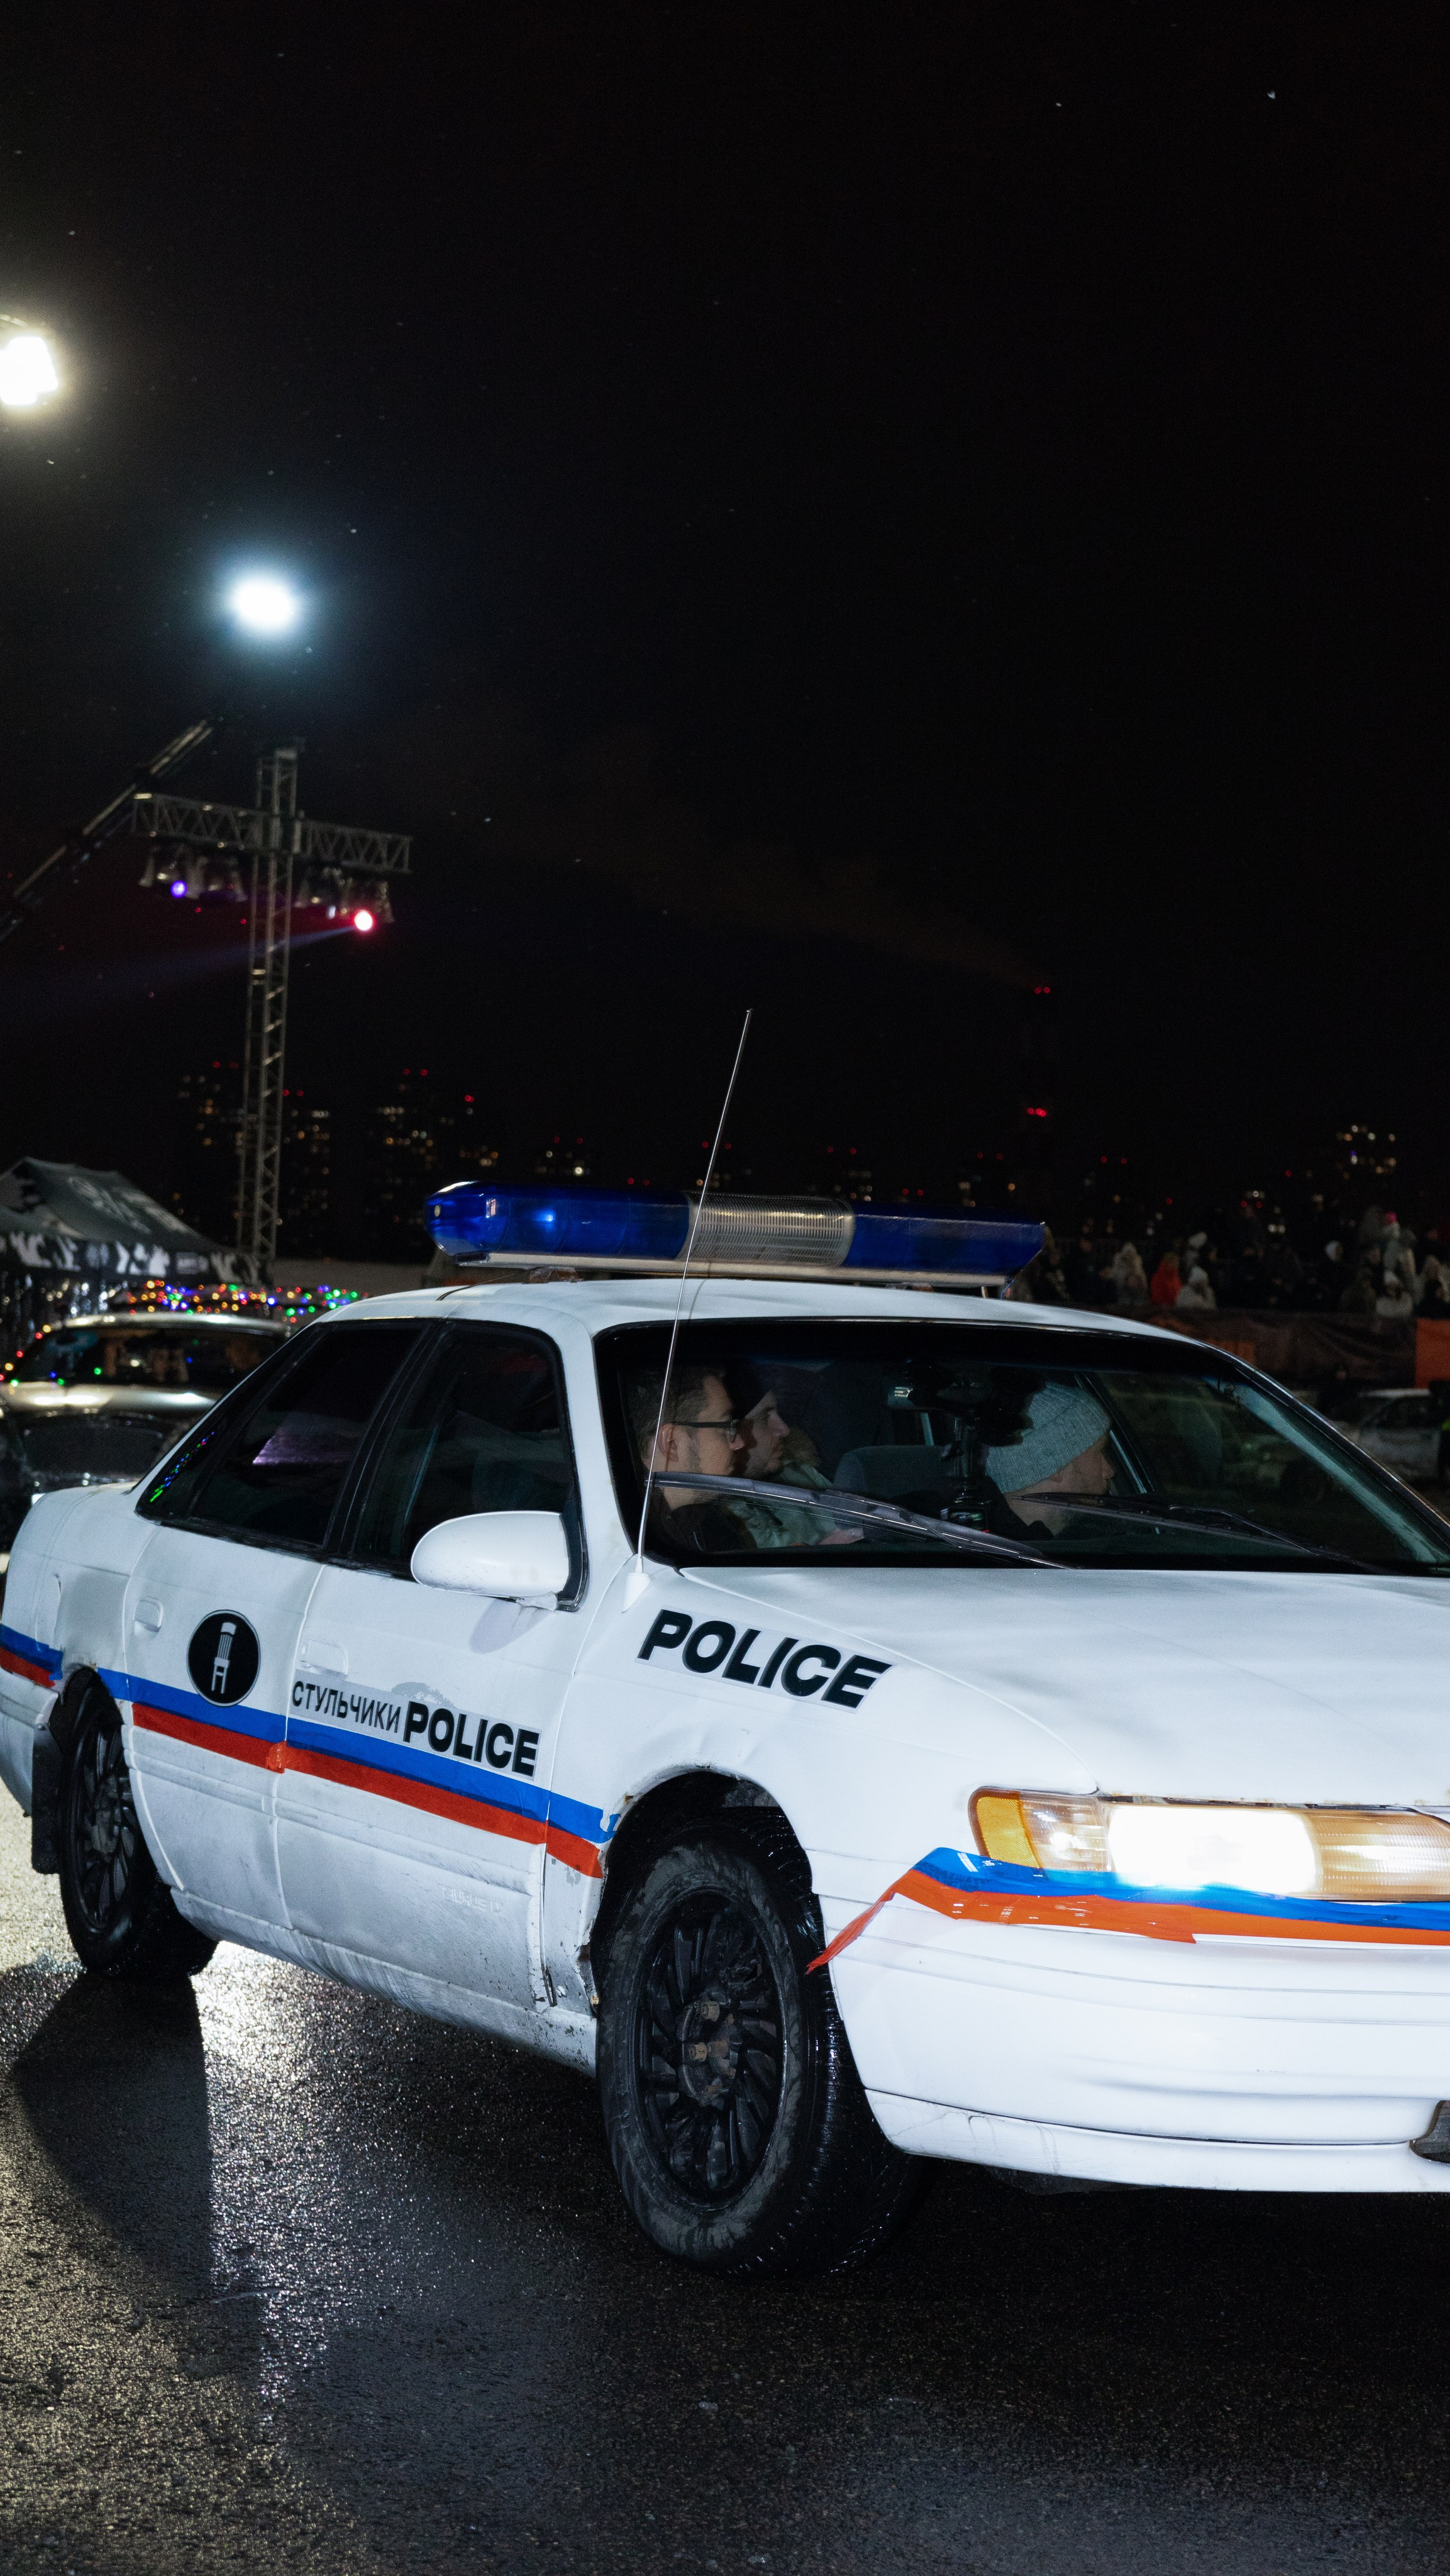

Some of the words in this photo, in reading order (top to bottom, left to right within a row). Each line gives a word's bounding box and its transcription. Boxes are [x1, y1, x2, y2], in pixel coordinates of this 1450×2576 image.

[637, 1609, 893, 1709] POLICE
[292, 1680, 401, 1734] СТУЛЬЧИКИ
[403, 1701, 540, 1777] POLICE
